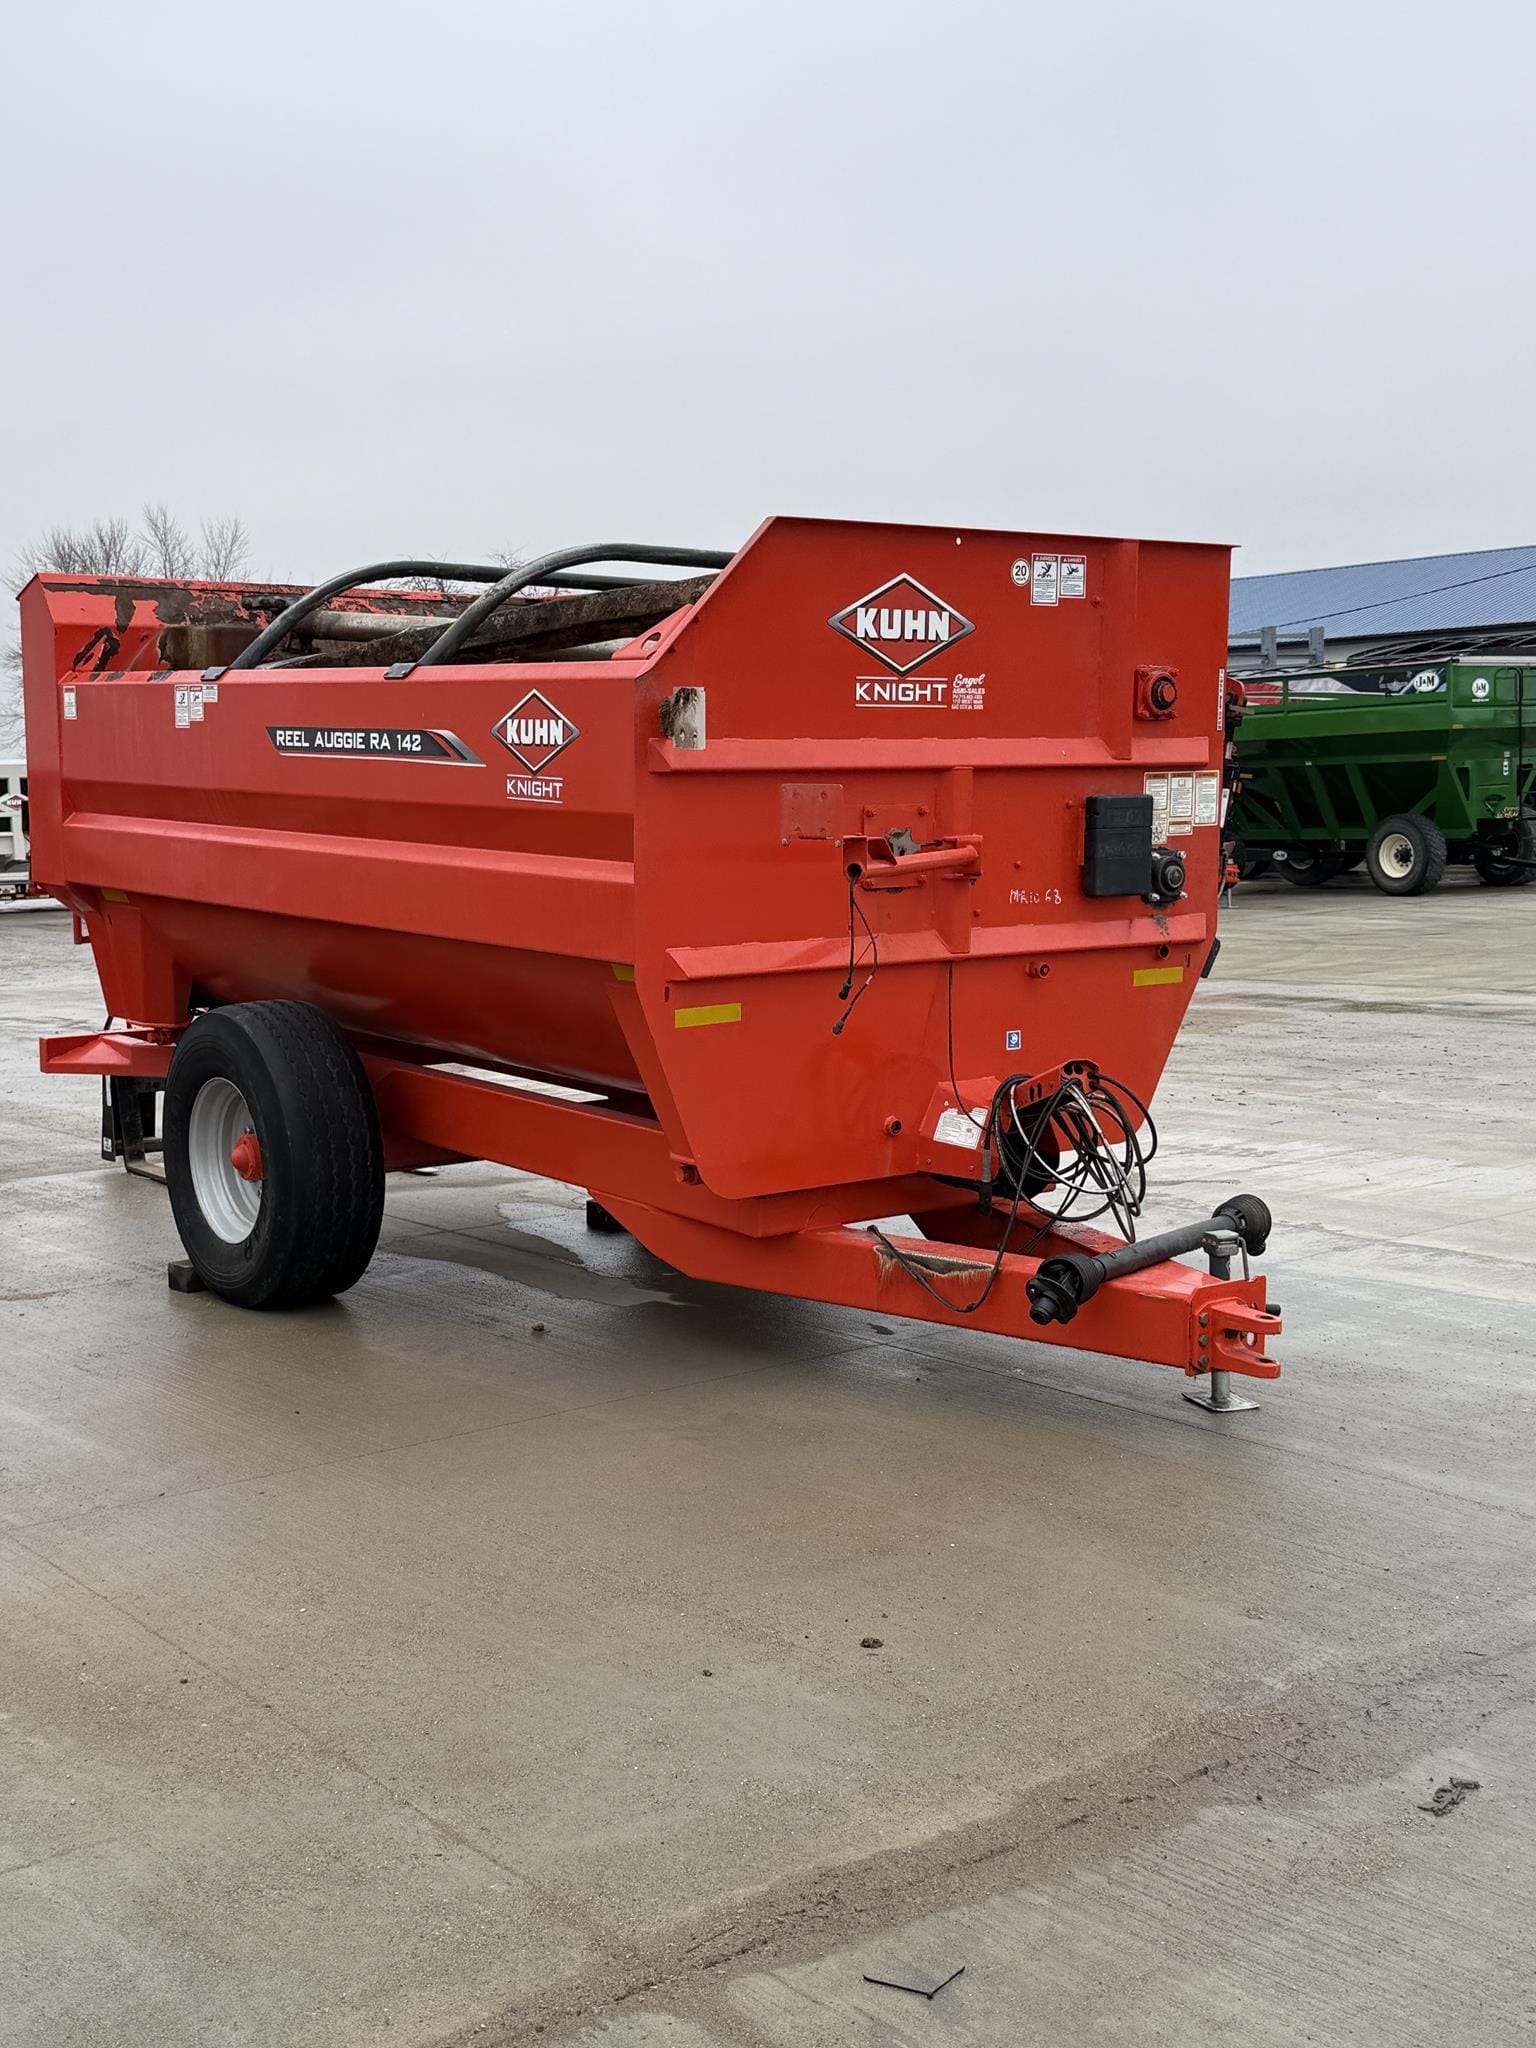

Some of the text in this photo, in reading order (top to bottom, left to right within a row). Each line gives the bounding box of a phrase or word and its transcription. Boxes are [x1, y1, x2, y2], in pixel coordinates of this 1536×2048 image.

[1015, 565, 1027, 576] 20
[856, 607, 950, 641] KUHN
[855, 682, 948, 702] KNIGHT
[276, 730, 422, 752] REEL AUGGIE RA 142
[506, 719, 564, 745] KUHN
[506, 779, 563, 798] KNIGHT
